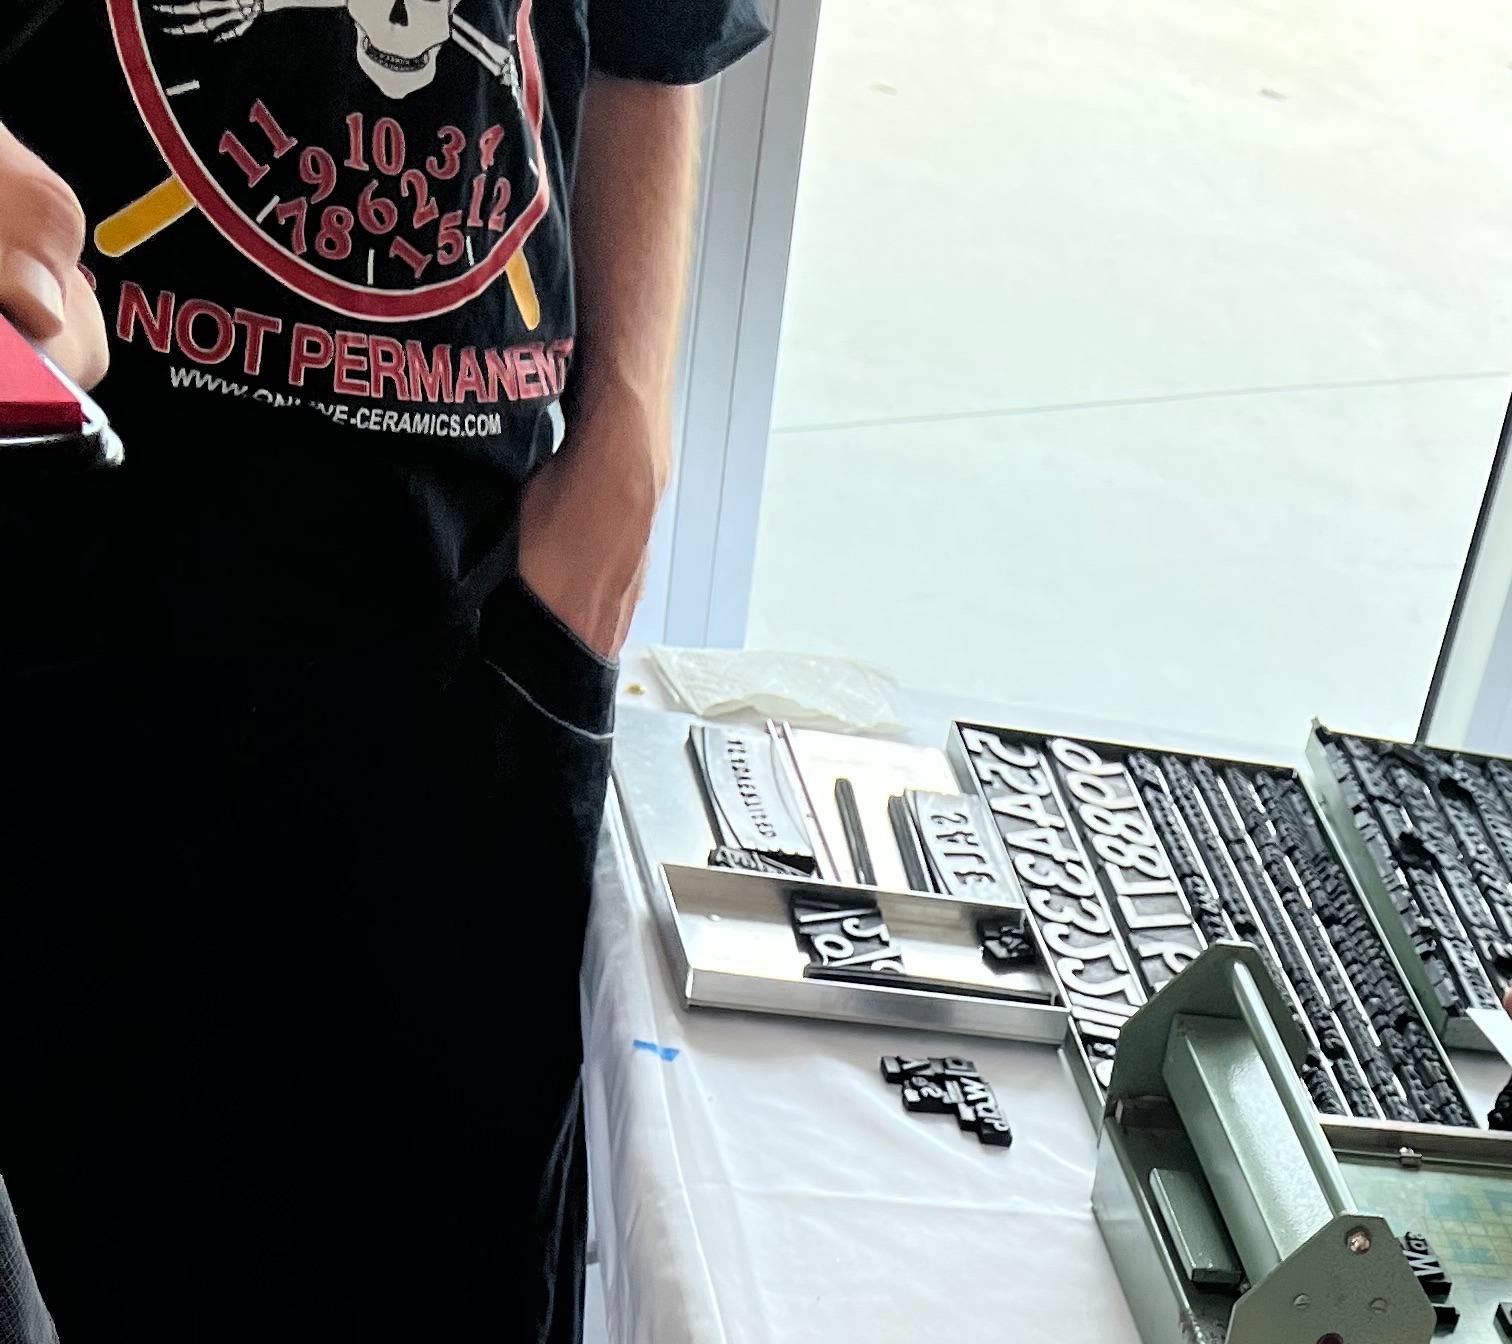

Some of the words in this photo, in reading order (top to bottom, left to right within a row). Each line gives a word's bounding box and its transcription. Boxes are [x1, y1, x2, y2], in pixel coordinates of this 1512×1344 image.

[219, 98, 297, 187] 11
[344, 112, 405, 176] 10
[426, 126, 465, 179] 3
[300, 147, 336, 204] 9
[401, 169, 438, 228] 2
[467, 174, 511, 231] 12
[275, 197, 307, 255] 7
[315, 206, 354, 259] 8
[358, 179, 397, 234] 6
[390, 236, 433, 278] 1
[437, 210, 464, 265] 5
[116, 280, 282, 375] NOT
[288, 323, 573, 403] PERMANENT
